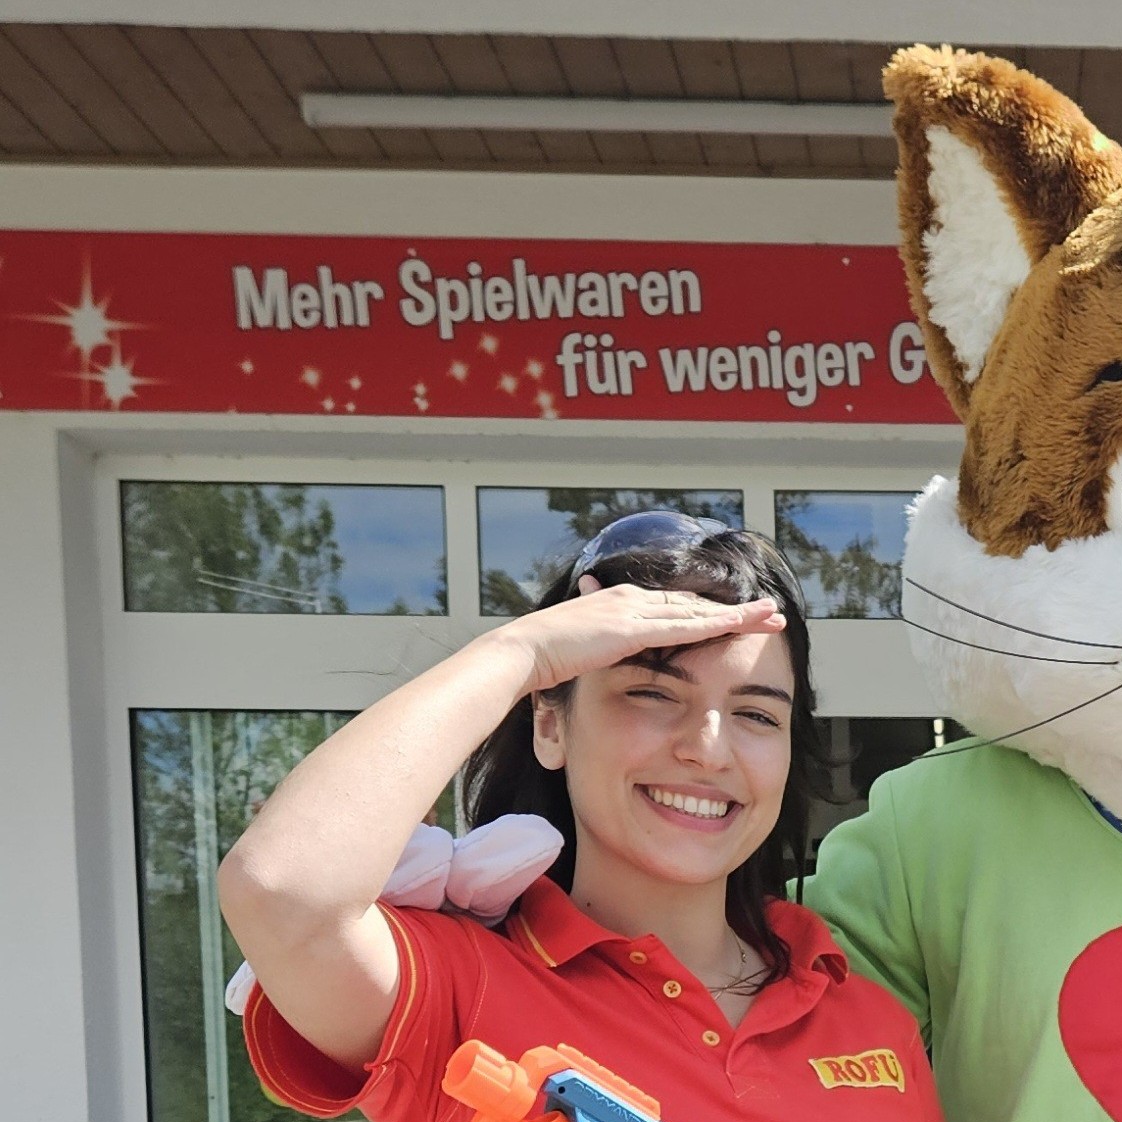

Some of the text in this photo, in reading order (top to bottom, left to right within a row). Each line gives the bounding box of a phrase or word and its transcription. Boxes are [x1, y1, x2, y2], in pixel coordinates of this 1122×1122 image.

[232, 258, 702, 340] Mehr Spielwaren
[556, 321, 928, 408] für weniger G
[822, 1053, 900, 1083] ROFU
